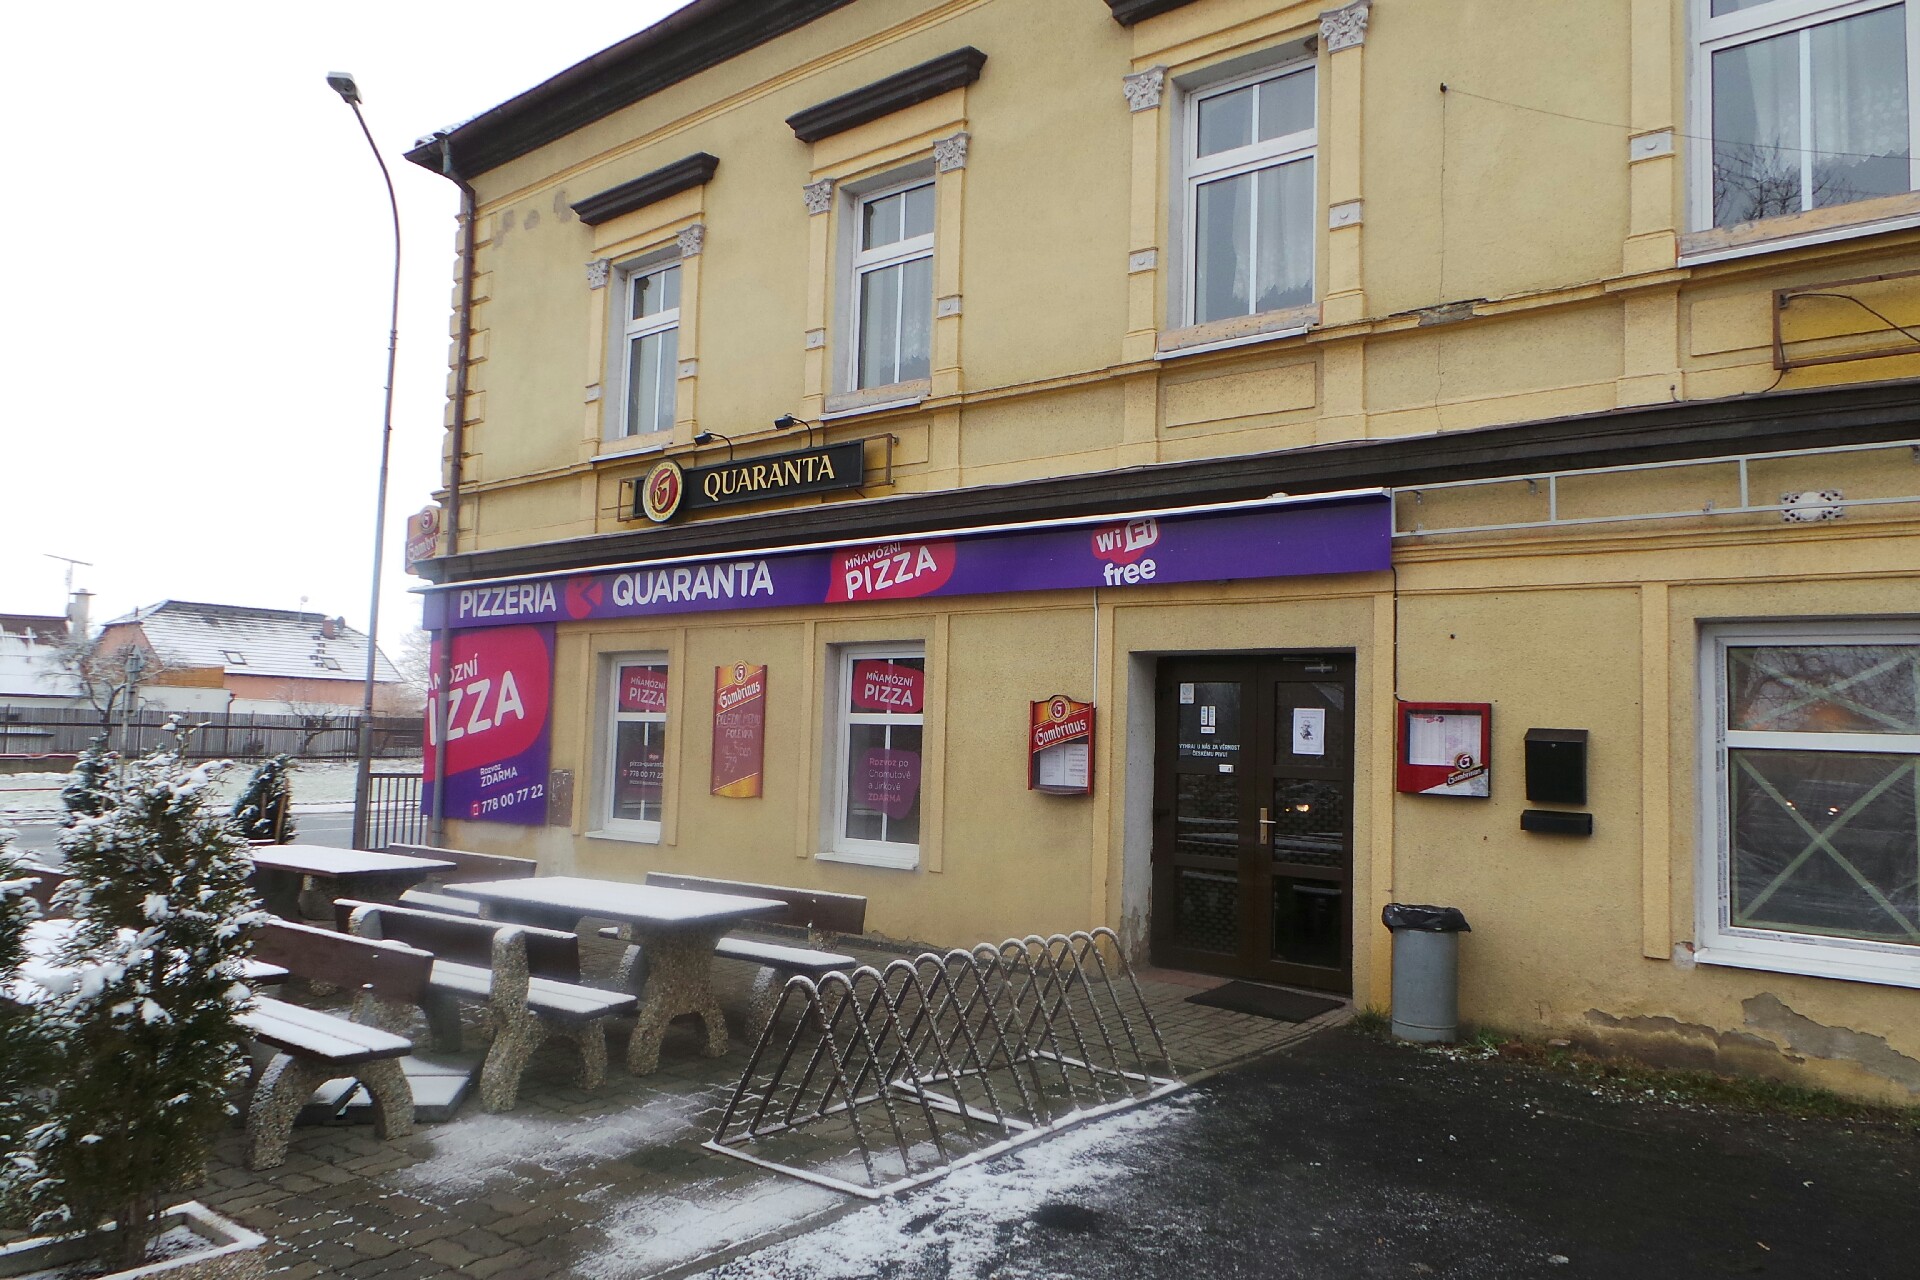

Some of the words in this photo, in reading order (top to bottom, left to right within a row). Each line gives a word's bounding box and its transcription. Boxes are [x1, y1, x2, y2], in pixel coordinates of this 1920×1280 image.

[704, 454, 835, 501] QUARANTA
[845, 542, 901, 570] MŇAMÓZNÍ
[845, 545, 937, 600] PIZZA
[1103, 559, 1156, 586] free
[459, 583, 556, 619] PIZZERIA
[612, 560, 774, 607] QUARANTA
[865, 671, 914, 687] MŇAMÓZNÍ
[629, 687, 666, 707] PIZZA
[719, 681, 761, 708] Gambrinus
[864, 683, 913, 707] PIZZA
[1034, 719, 1087, 746] Gambrinus
[480, 764, 502, 776] Rozvoz
[640, 770, 649, 778] 00
[649, 771, 656, 779] 77
[868, 769, 911, 780] Chomutově
[869, 758, 897, 767] Rozvoz
[898, 760, 909, 768] po
[481, 766, 518, 788] ZDARMA
[1448, 768, 1481, 784] Gambrinus
[481, 797, 499, 814] 778
[500, 792, 515, 807] 00
[516, 787, 529, 803] 77
[531, 784, 544, 799] 22
[867, 793, 903, 803] ZDARMA
